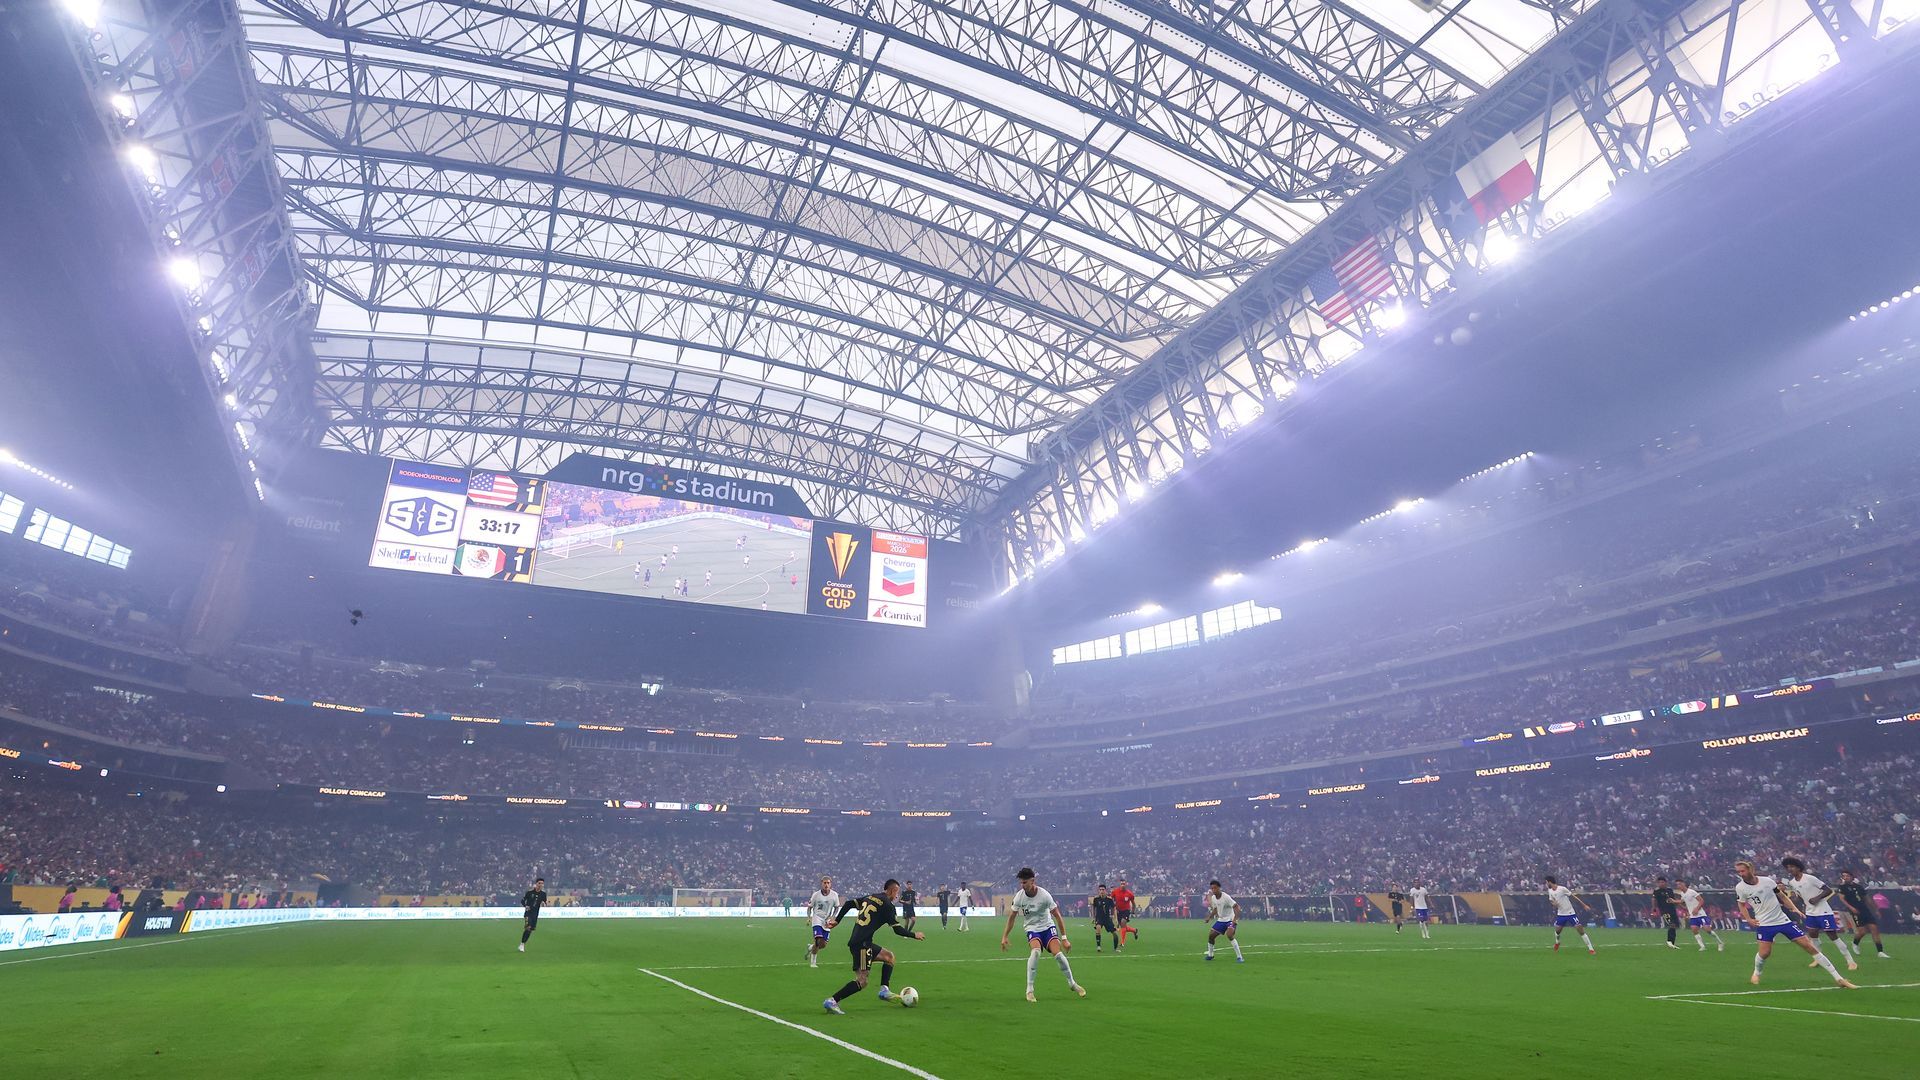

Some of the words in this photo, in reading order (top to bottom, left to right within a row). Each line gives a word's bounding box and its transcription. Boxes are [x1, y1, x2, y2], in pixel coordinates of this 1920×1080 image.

[601, 466, 644, 492] nrg
[674, 478, 774, 507] stadium
[526, 486, 535, 502] 1
[287, 515, 341, 533] reliant
[479, 518, 521, 535] 33:17
[378, 547, 400, 559] Shell
[414, 551, 448, 565] Federal
[883, 557, 916, 568] Chevron
[514, 555, 523, 571] 1
[821, 586, 856, 600] GOLD
[825, 598, 851, 610] CUP
[883, 610, 922, 622] Carnival
[1773, 687, 1793, 697] GOLD
[1797, 684, 1812, 692] CUP
[312, 701, 336, 709] FOLLOW
[335, 704, 365, 713] CONCACAF
[1613, 714, 1631, 723] 33:17
[1703, 735, 1747, 749] FOLLOW
[1748, 728, 1809, 743] CONCACAF
[1614, 752, 1632, 760] GOLD
[1637, 749, 1651, 757] CUP
[1475, 767, 1507, 777] FOLLOW
[1508, 762, 1551, 773] CONCACAF
[319, 787, 349, 796] FOLLOW
[349, 789, 386, 798] CONCACAF
[1308, 788, 1333, 796] FOLLOW
[1334, 783, 1366, 792] CONCACAF
[1195, 799, 1222, 807] CONCACAF
[1752, 896, 1762, 905] 13
[857, 901, 878, 927] 25
[99, 922, 115, 936] Midea
[144, 917, 173, 930] HOUSTON
[1823, 919, 1830, 927] 3
[24, 926, 45, 943] Midea
[77, 923, 94, 938] Midea
